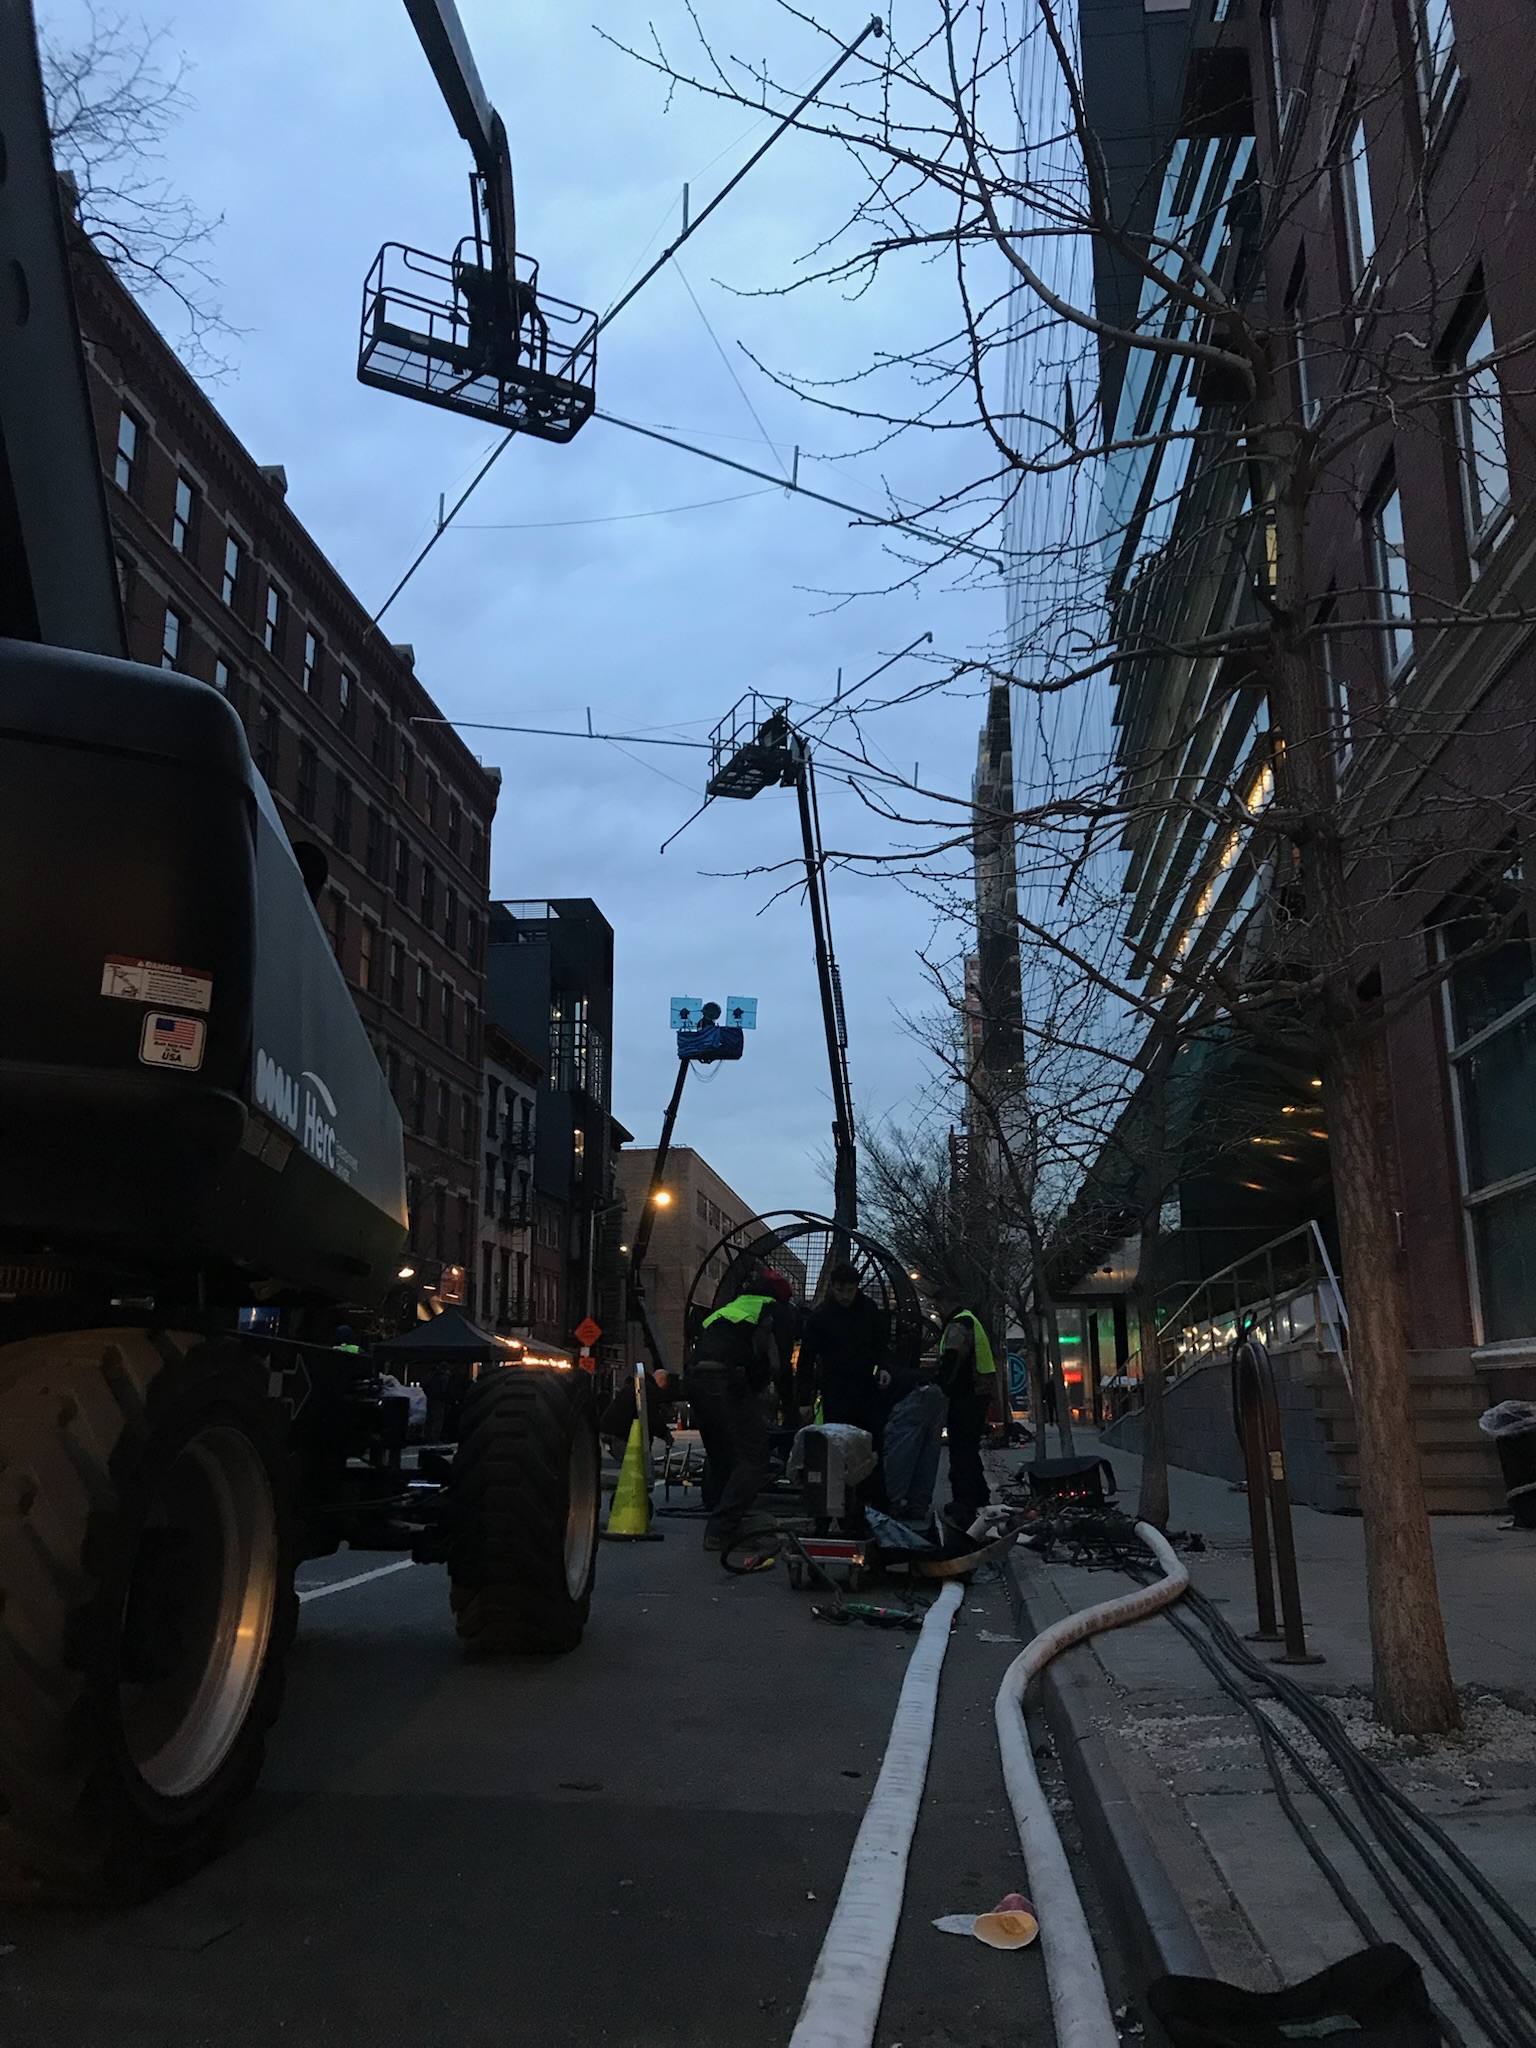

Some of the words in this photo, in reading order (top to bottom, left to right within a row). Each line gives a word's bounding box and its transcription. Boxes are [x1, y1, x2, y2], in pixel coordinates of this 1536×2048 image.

[145, 961, 183, 973] DANGER
[162, 1052, 181, 1062] USA
[303, 1090, 336, 1169] Herc
